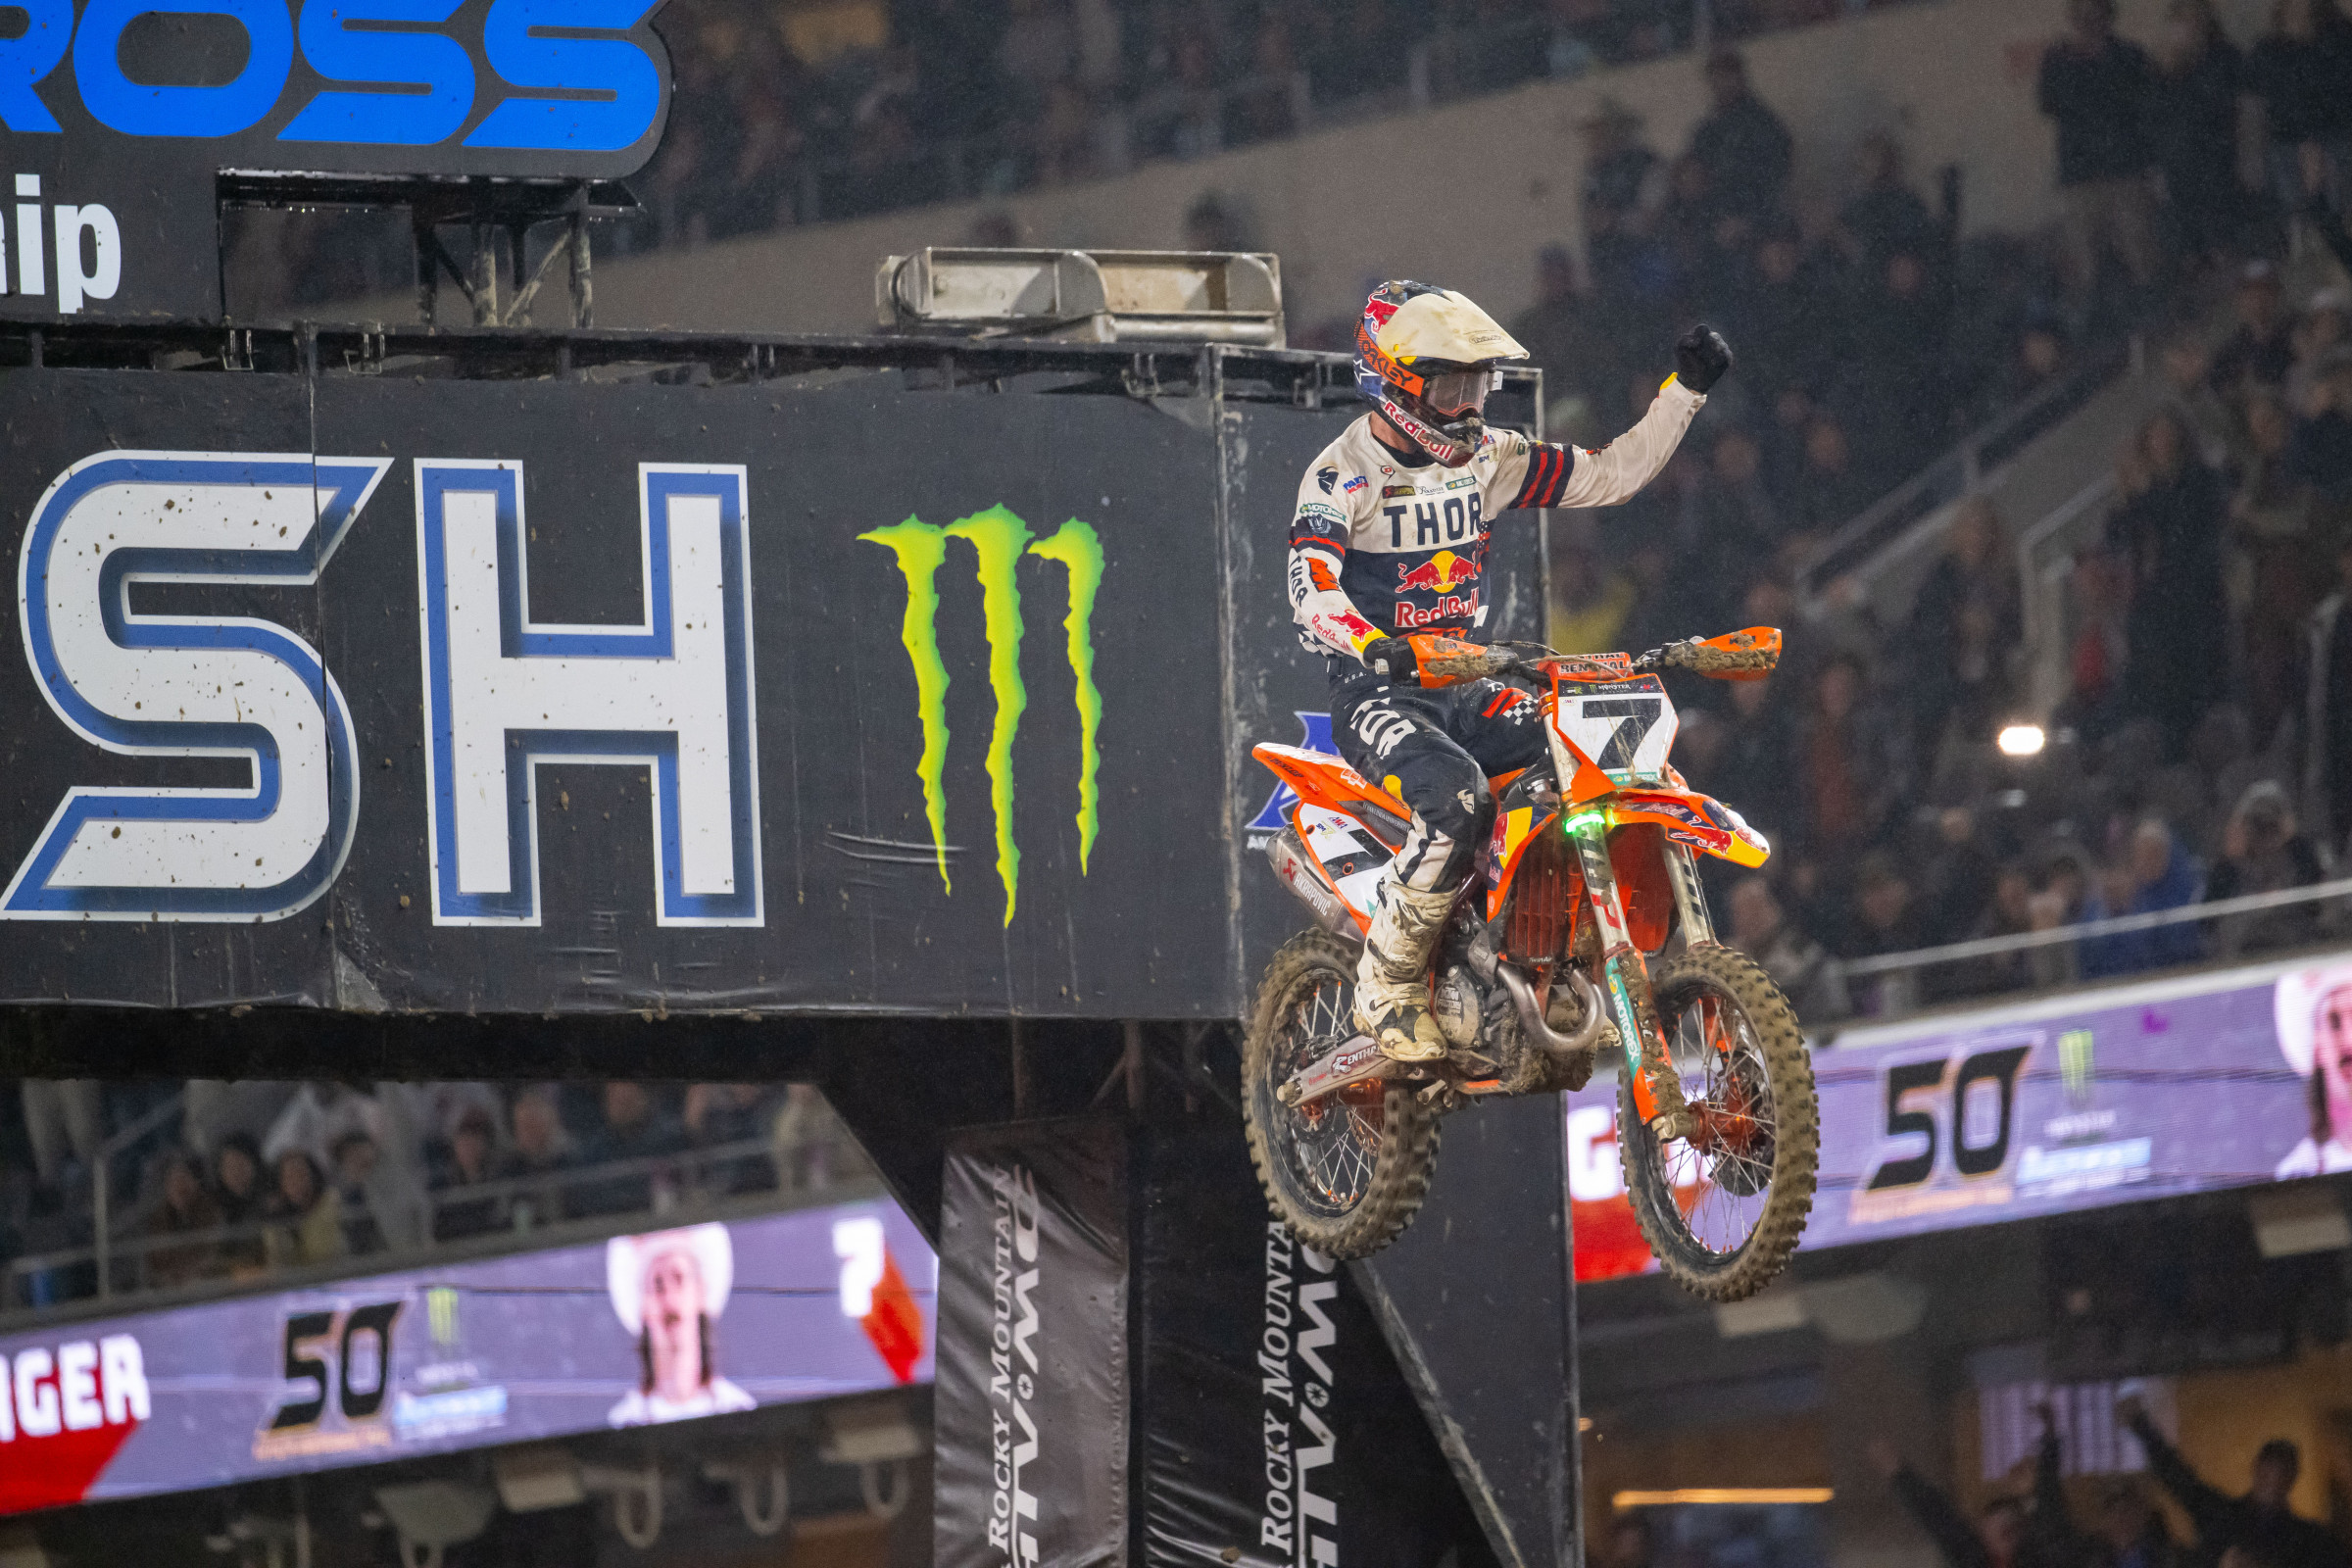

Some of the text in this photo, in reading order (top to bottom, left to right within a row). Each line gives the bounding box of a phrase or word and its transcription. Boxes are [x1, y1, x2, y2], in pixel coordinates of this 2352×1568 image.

[0, 174, 121, 314] ip
[1362, 340, 1413, 386] OAKLEY
[1383, 491, 1482, 550] THOR
[1289, 555, 1308, 609] THOR
[1344, 670, 1367, 684] U.S.A.
[1560, 661, 1627, 673] RENAL
[1582, 698, 1662, 770] 7
[1623, 773, 1658, 782] MOREX
[1613, 993, 1641, 1062] MOTOREX
[1331, 1045, 1381, 1076] RENTHA
[1868, 1045, 2034, 1191] 50
[271, 1300, 405, 1430] 50
[1257, 1221, 1294, 1556] ROCKY MOUNTA
[989, 1408, 1011, 1555] ROCKY
